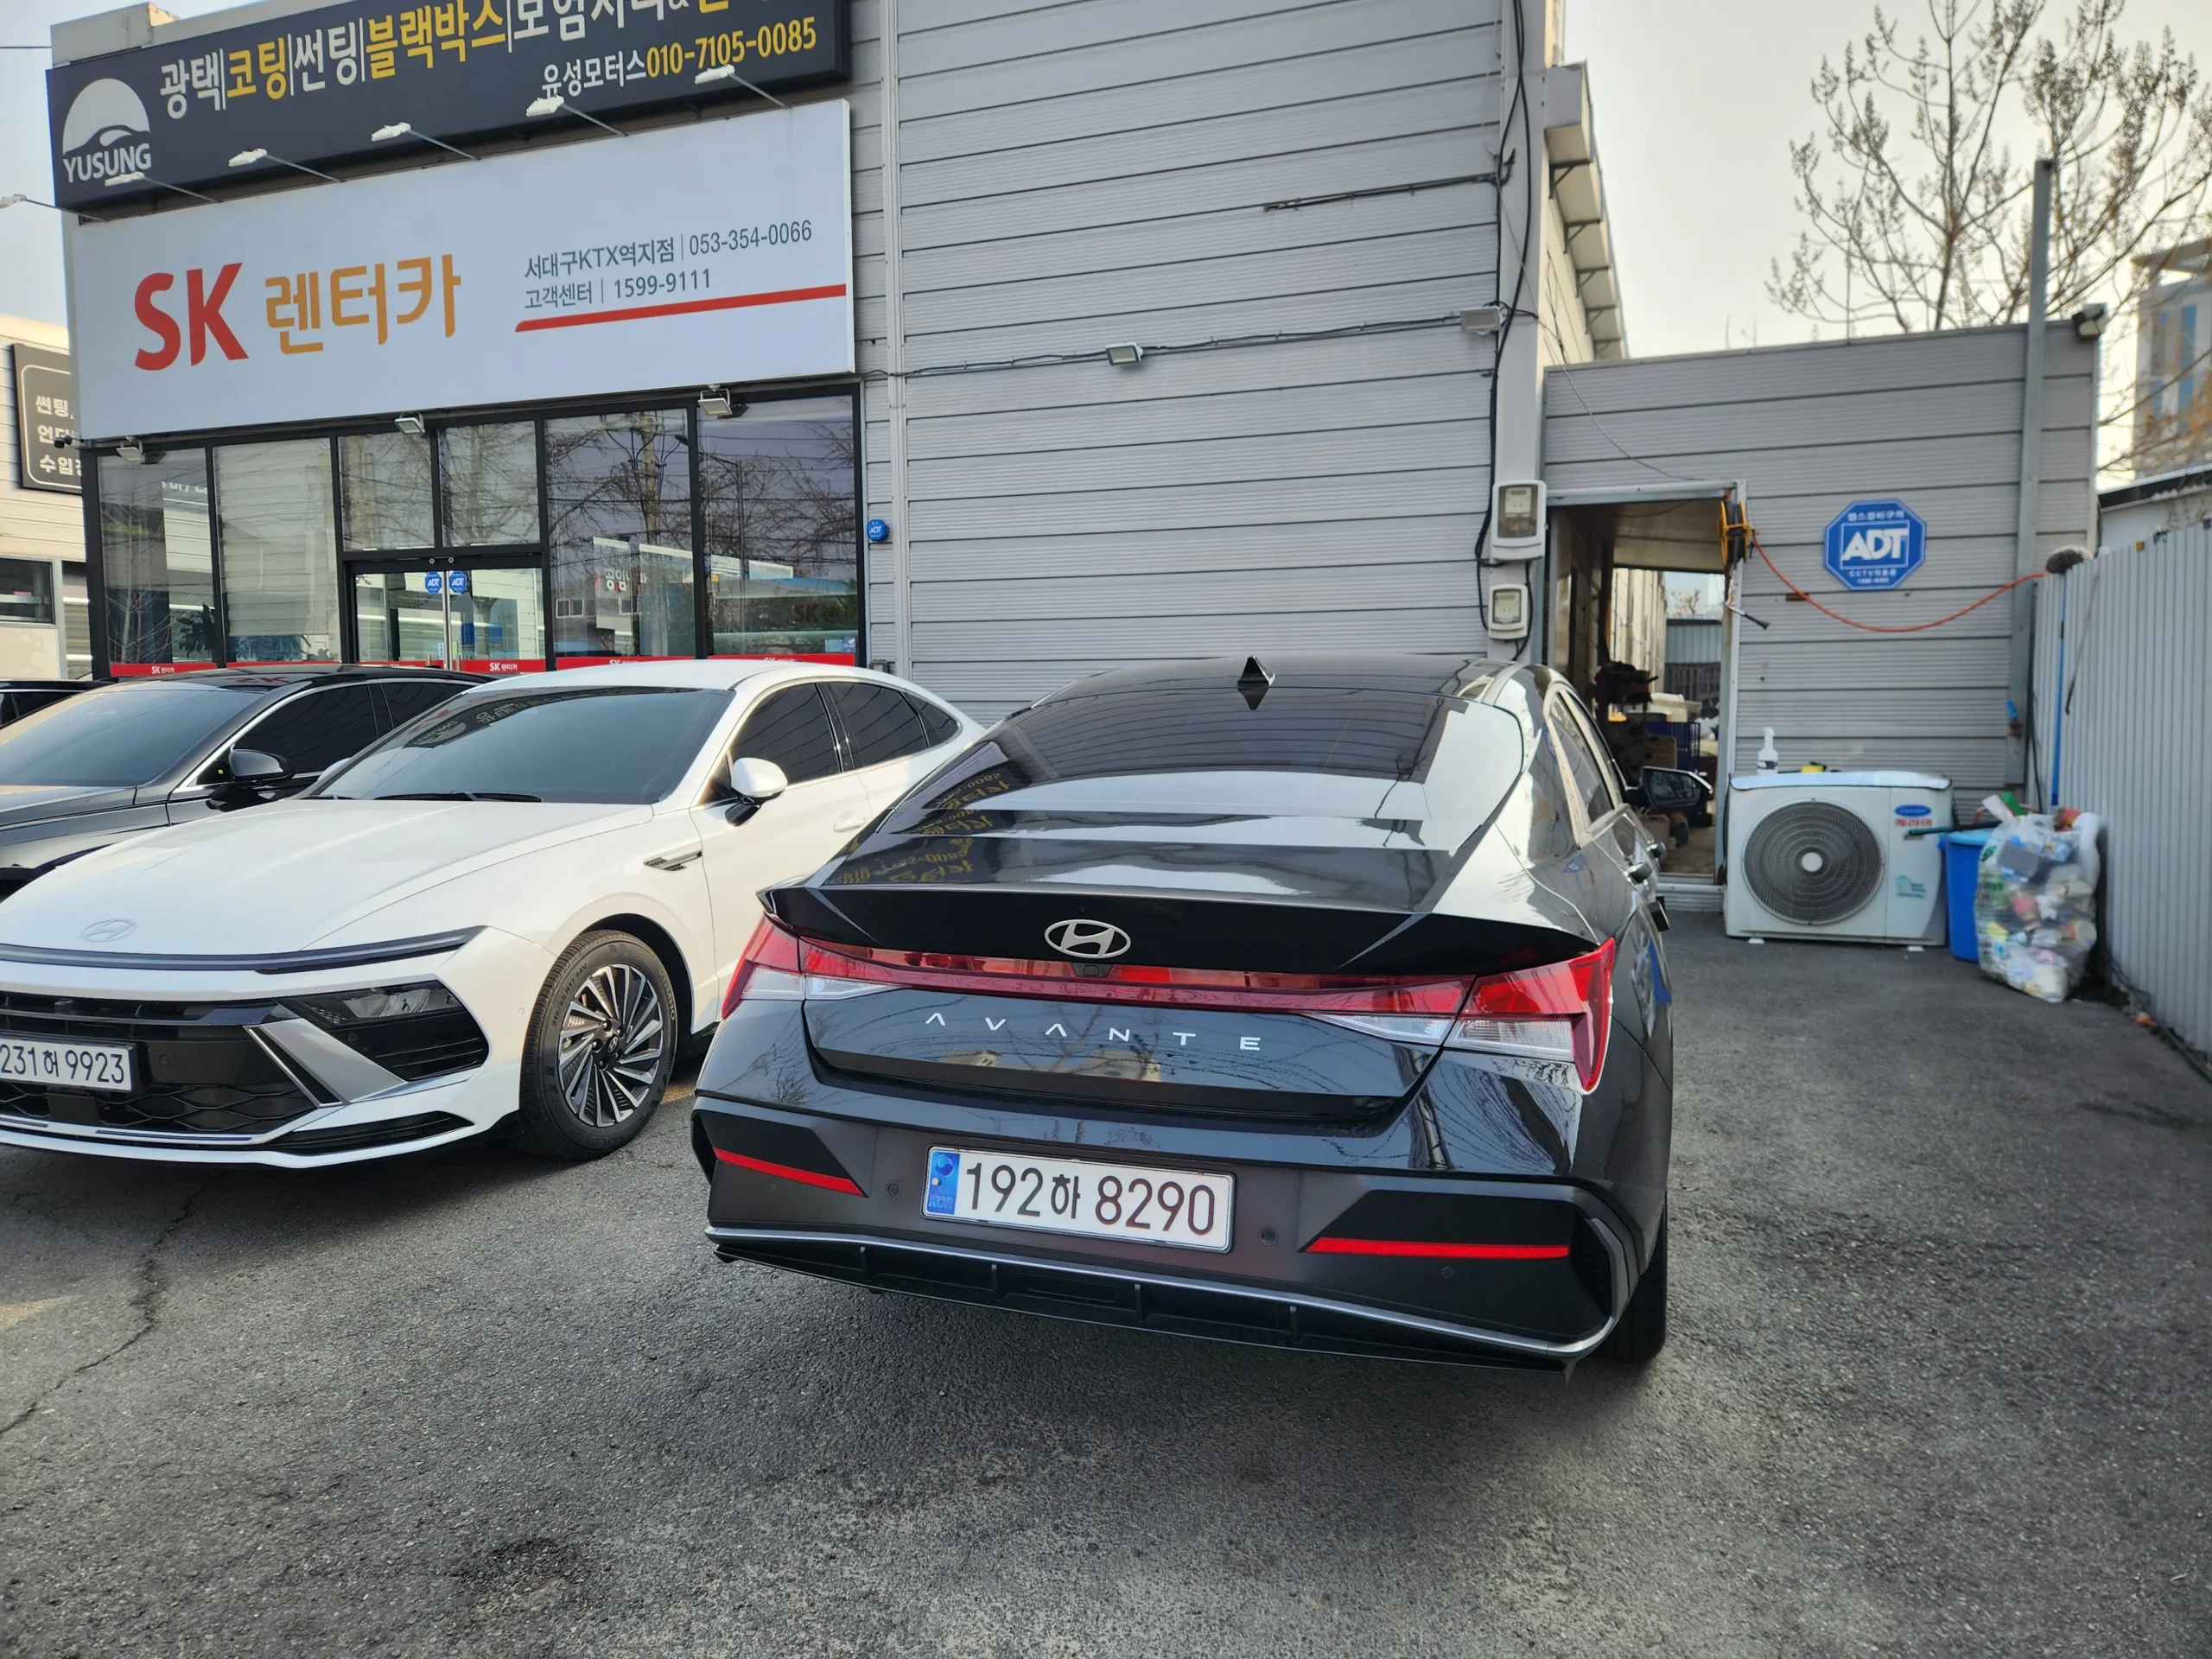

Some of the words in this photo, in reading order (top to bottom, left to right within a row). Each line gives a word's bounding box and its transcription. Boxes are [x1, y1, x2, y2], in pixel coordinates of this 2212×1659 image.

[160, 54, 220, 119] 광택
[226, 37, 288, 99] 코팅
[294, 27, 358, 91] 썬팅
[365, 0, 505, 79] 블랙박스
[62, 143, 151, 183] YUSUNG
[524, 238, 675, 281] 서대구KTX역지점
[689, 219, 812, 256] 053-354-0066
[524, 281, 593, 310] 고객센터
[613, 268, 711, 299] 1599-9111
[134, 262, 249, 371] SK
[265, 254, 462, 355] 렌터카
[1840, 528, 1909, 561] ADT
[428, 578, 440, 587] ADT
[452, 577, 464, 586] ADT
[490, 662, 500, 671] SK
[925, 1013, 1262, 1052] AVANTE
[66, 1049, 124, 1084] 9923
[928, 1194, 954, 1210] KOR
[966, 1162, 1080, 1219] 192하
[1096, 1175, 1215, 1236] 8290
